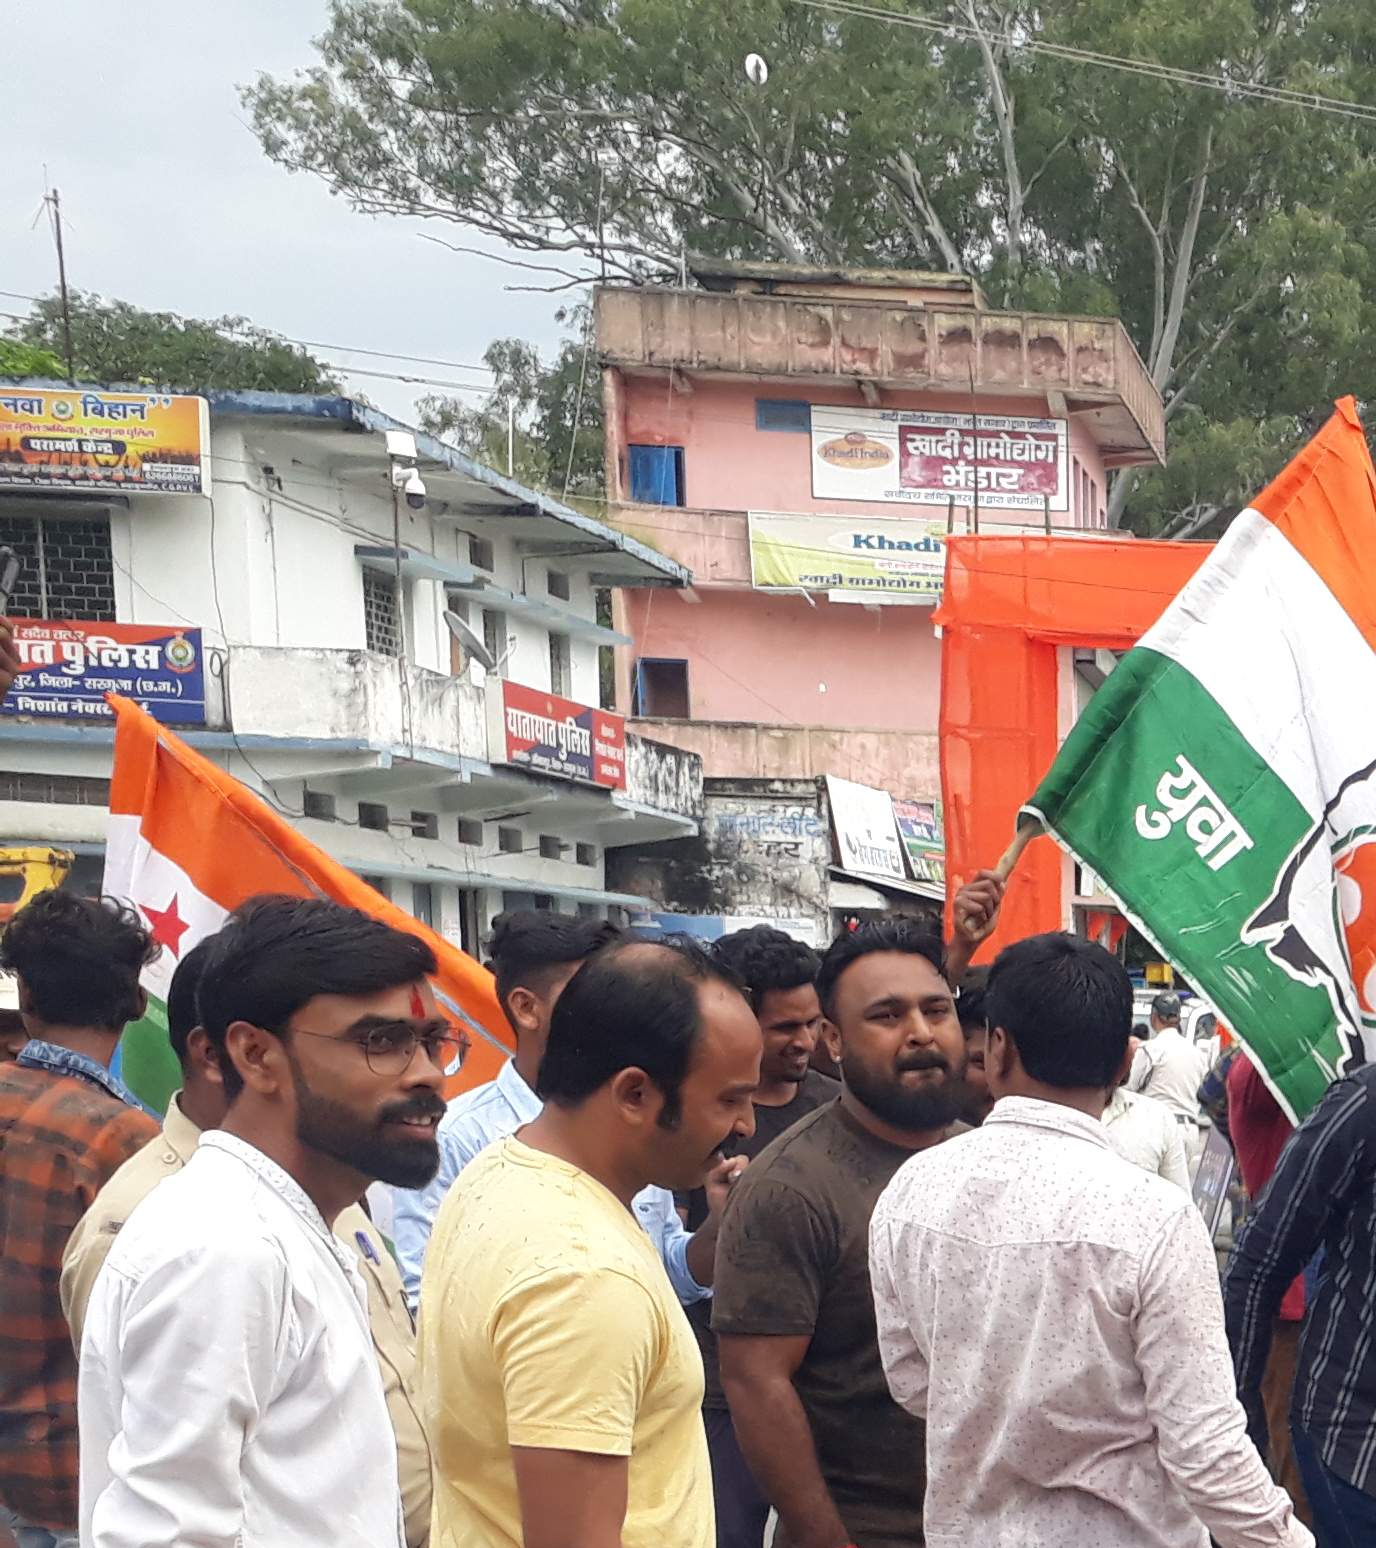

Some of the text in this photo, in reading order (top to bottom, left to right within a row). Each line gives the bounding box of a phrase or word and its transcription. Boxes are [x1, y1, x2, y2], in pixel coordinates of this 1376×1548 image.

[824, 447, 858, 459] Khadi
[906, 429, 1057, 463] खादी ग्रामोद्योग
[942, 461, 1025, 489] भंडार
[852, 534, 942, 553] Khadi
[60, 635, 163, 675] पुलिस
[506, 706, 558, 749] यातायात
[557, 716, 592, 761] पुलिस
[1135, 755, 1255, 873] युवा
